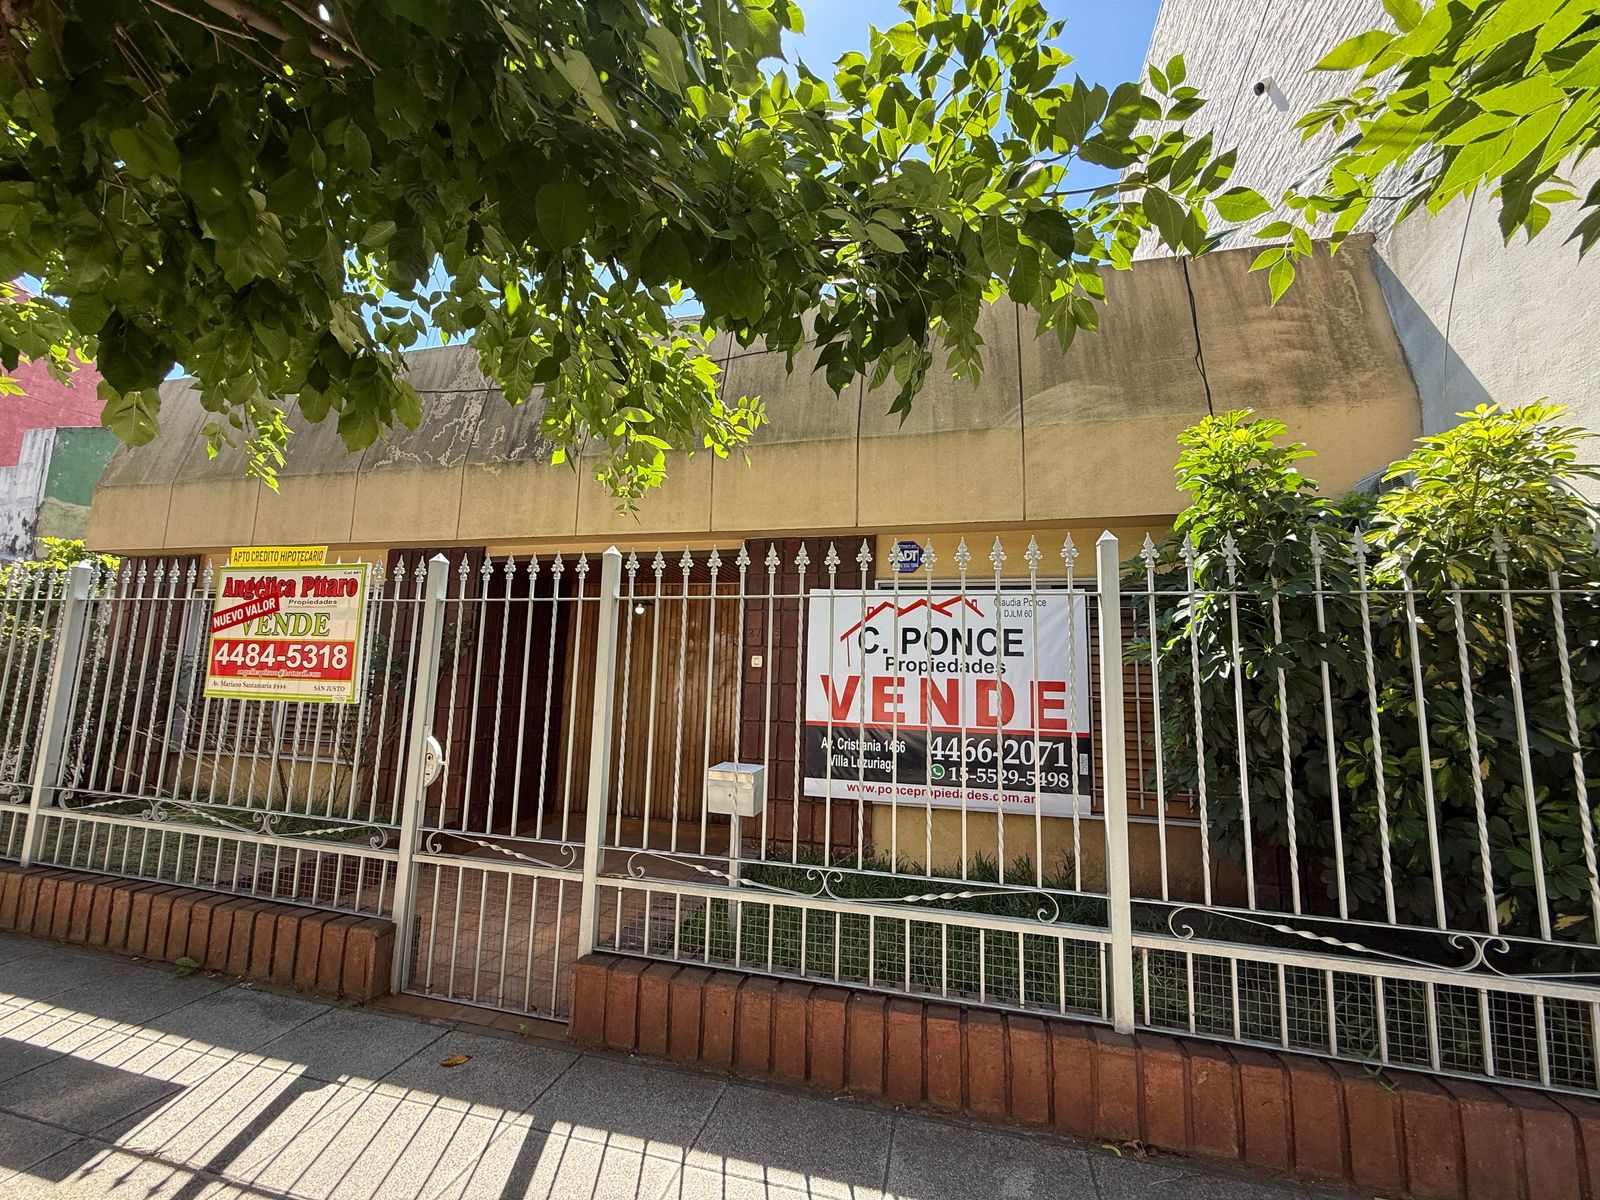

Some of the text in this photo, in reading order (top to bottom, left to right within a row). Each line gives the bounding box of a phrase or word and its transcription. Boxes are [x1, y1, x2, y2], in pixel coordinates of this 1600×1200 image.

[234, 550, 324, 562] APTO CREDITO HIPOTECARIO
[222, 575, 359, 600] Angélica Pitaro
[212, 597, 276, 629] NUEVO VALOR
[994, 598, 1047, 607] audia Poce
[1004, 609, 1023, 618] DJLM
[242, 612, 331, 637] VENDE
[858, 626, 1025, 657] C. PONCE
[215, 642, 348, 670] 4484-5318
[885, 656, 1007, 676] Propiedades
[220, 680, 242, 688] Mariano
[820, 674, 1068, 730] VENDE
[837, 737, 882, 752] Cristania
[884, 740, 906, 753] 1466
[930, 736, 1069, 767] 4466-2071
[831, 754, 896, 773] Villa Lzuriag
[948, 767, 1070, 788] 15-5529-5498
